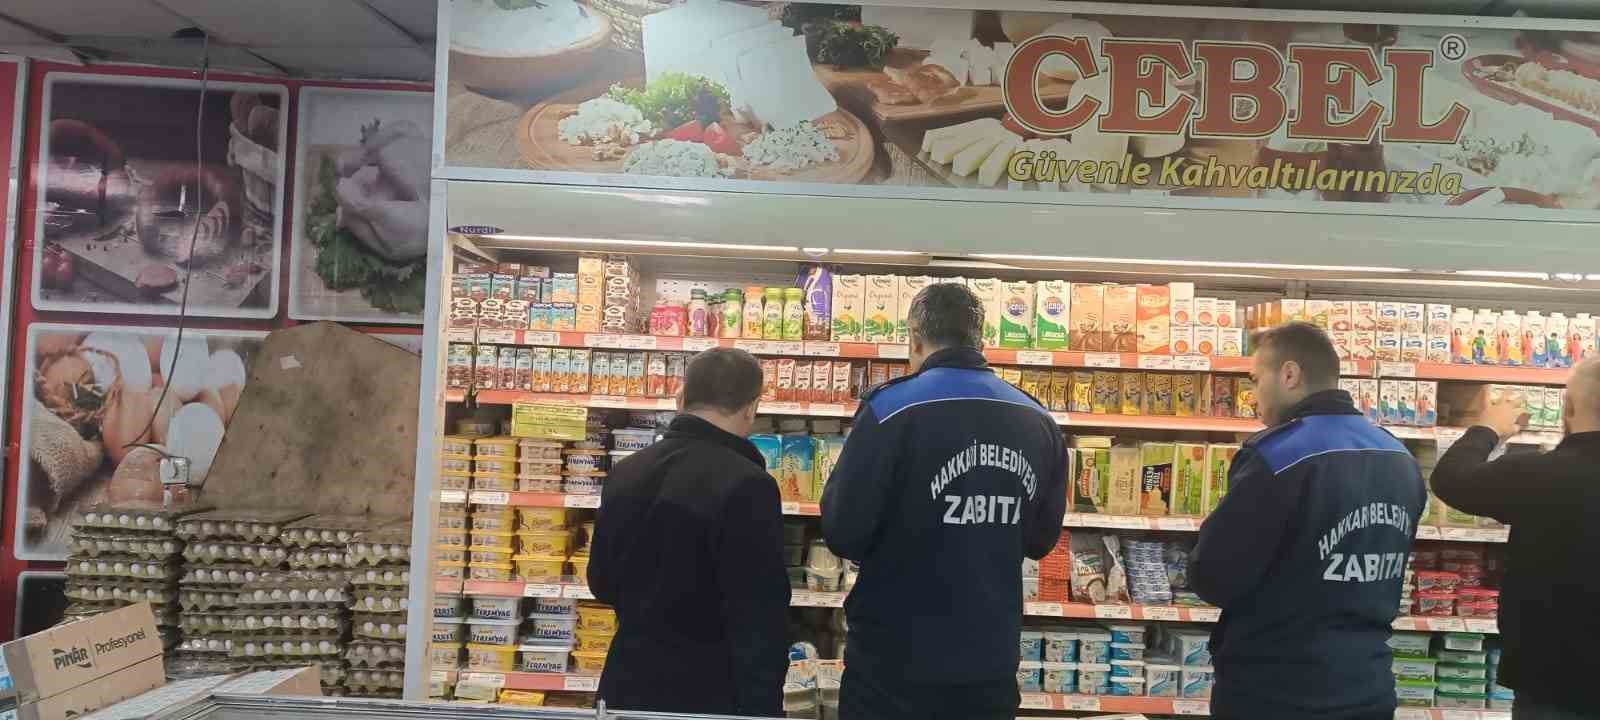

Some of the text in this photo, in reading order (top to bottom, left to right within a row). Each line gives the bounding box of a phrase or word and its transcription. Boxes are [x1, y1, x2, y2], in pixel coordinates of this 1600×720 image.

[1003, 35, 1470, 144] CEBEL
[1007, 150, 1462, 195] Güvenle Kahvaltılarınızda
[943, 495, 1022, 525] ZABITA
[1323, 552, 1405, 582] ZABITA
[94, 627, 146, 656] Profesyonel
